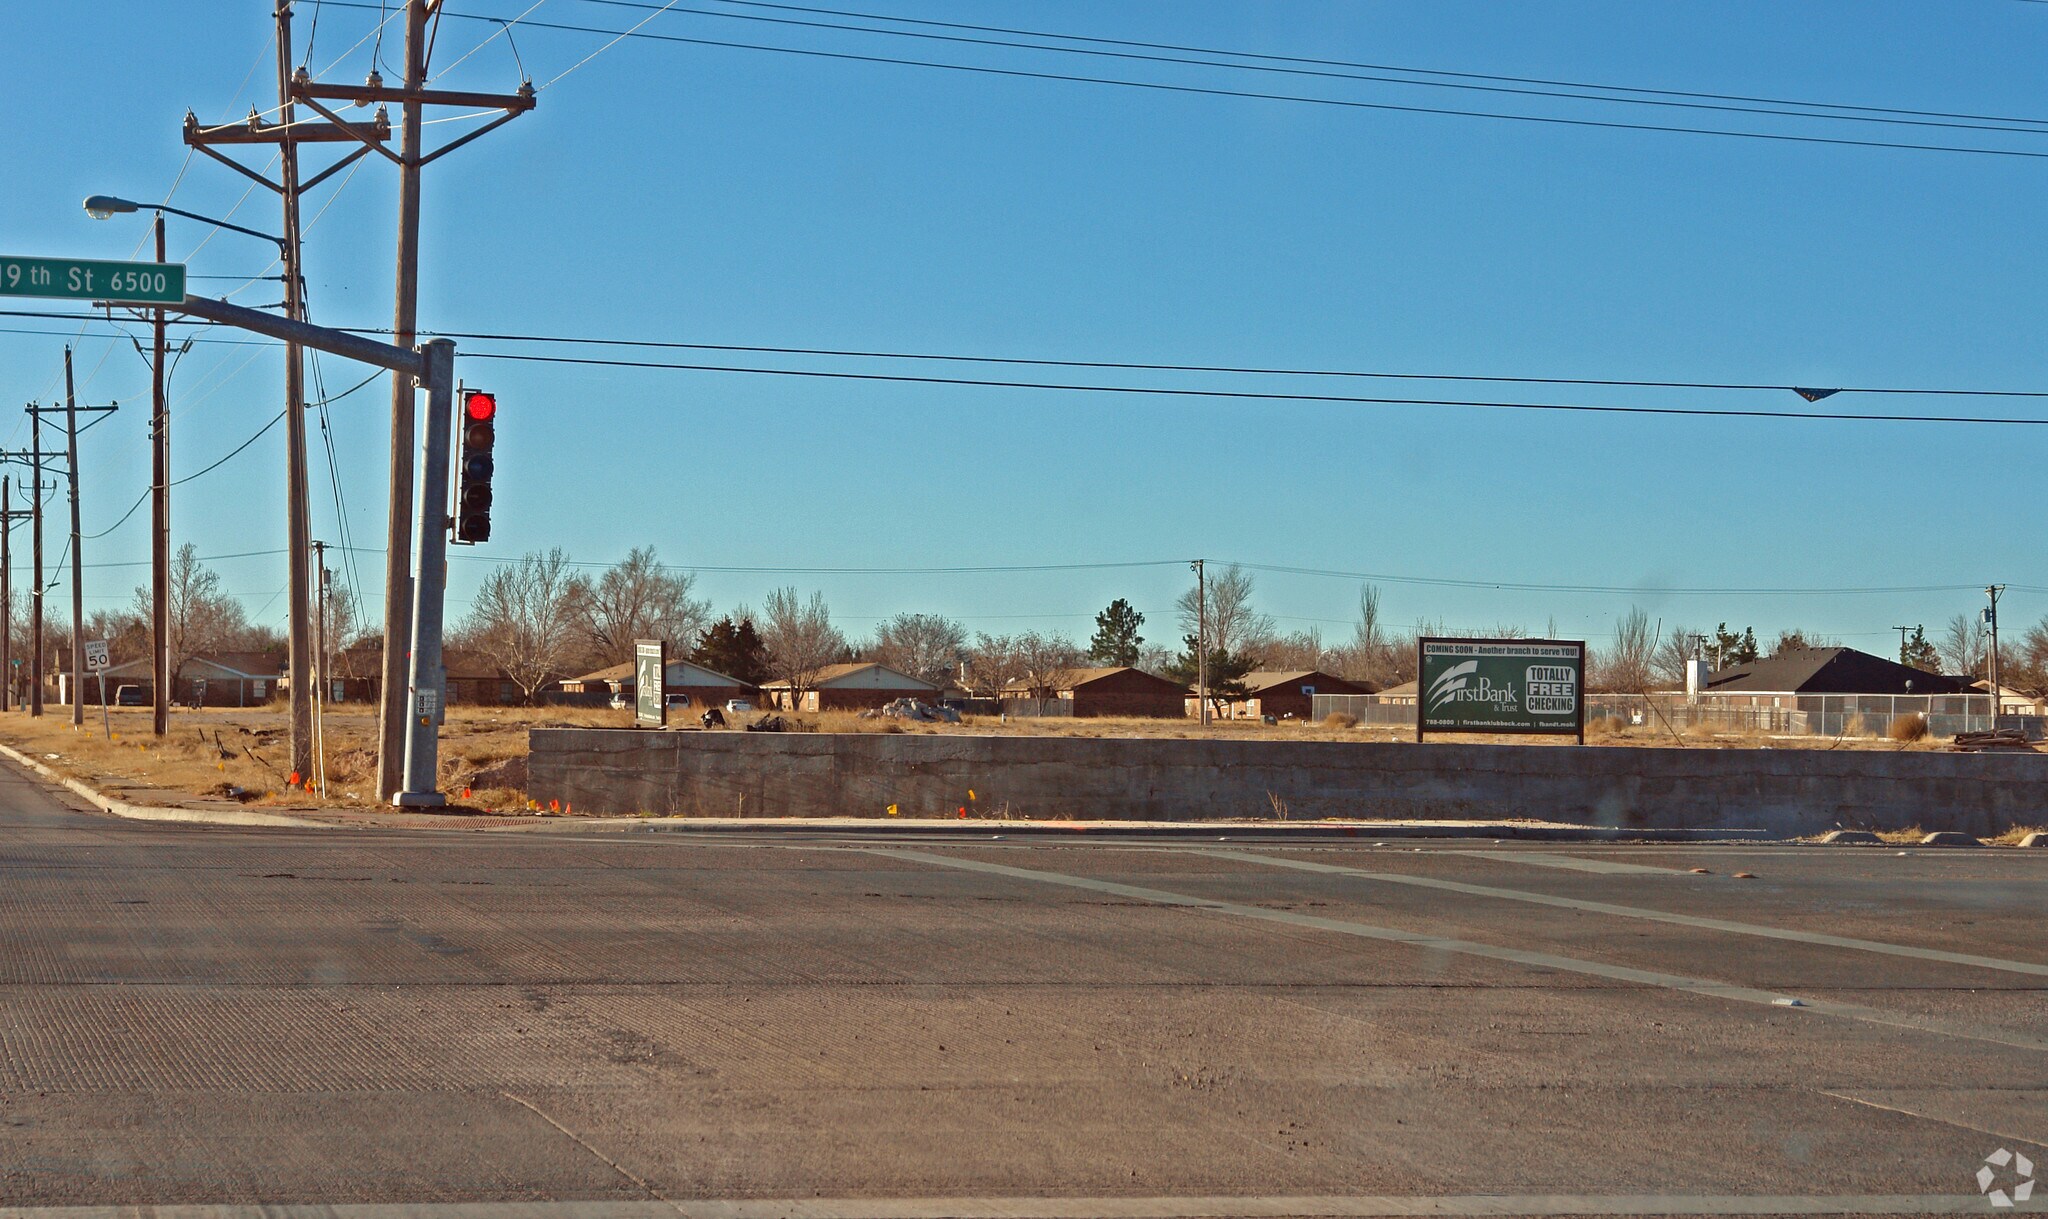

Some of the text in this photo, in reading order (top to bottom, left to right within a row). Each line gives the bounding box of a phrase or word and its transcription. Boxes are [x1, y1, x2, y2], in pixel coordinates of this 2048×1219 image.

[67, 267, 94, 292] St
[110, 271, 166, 293] 6500
[1426, 644, 1454, 654] COMING
[1454, 645, 1474, 654] SOON
[1478, 646, 1506, 655] Another
[1506, 646, 1531, 655] branch
[1532, 647, 1540, 655] to
[1561, 648, 1577, 656] YOU!
[89, 654, 108, 666] 50
[1531, 667, 1571, 681] TOTALLY
[1529, 683, 1572, 696] FREE
[1493, 702, 1518, 712] & Trust
[1528, 697, 1573, 711] CHECKING
